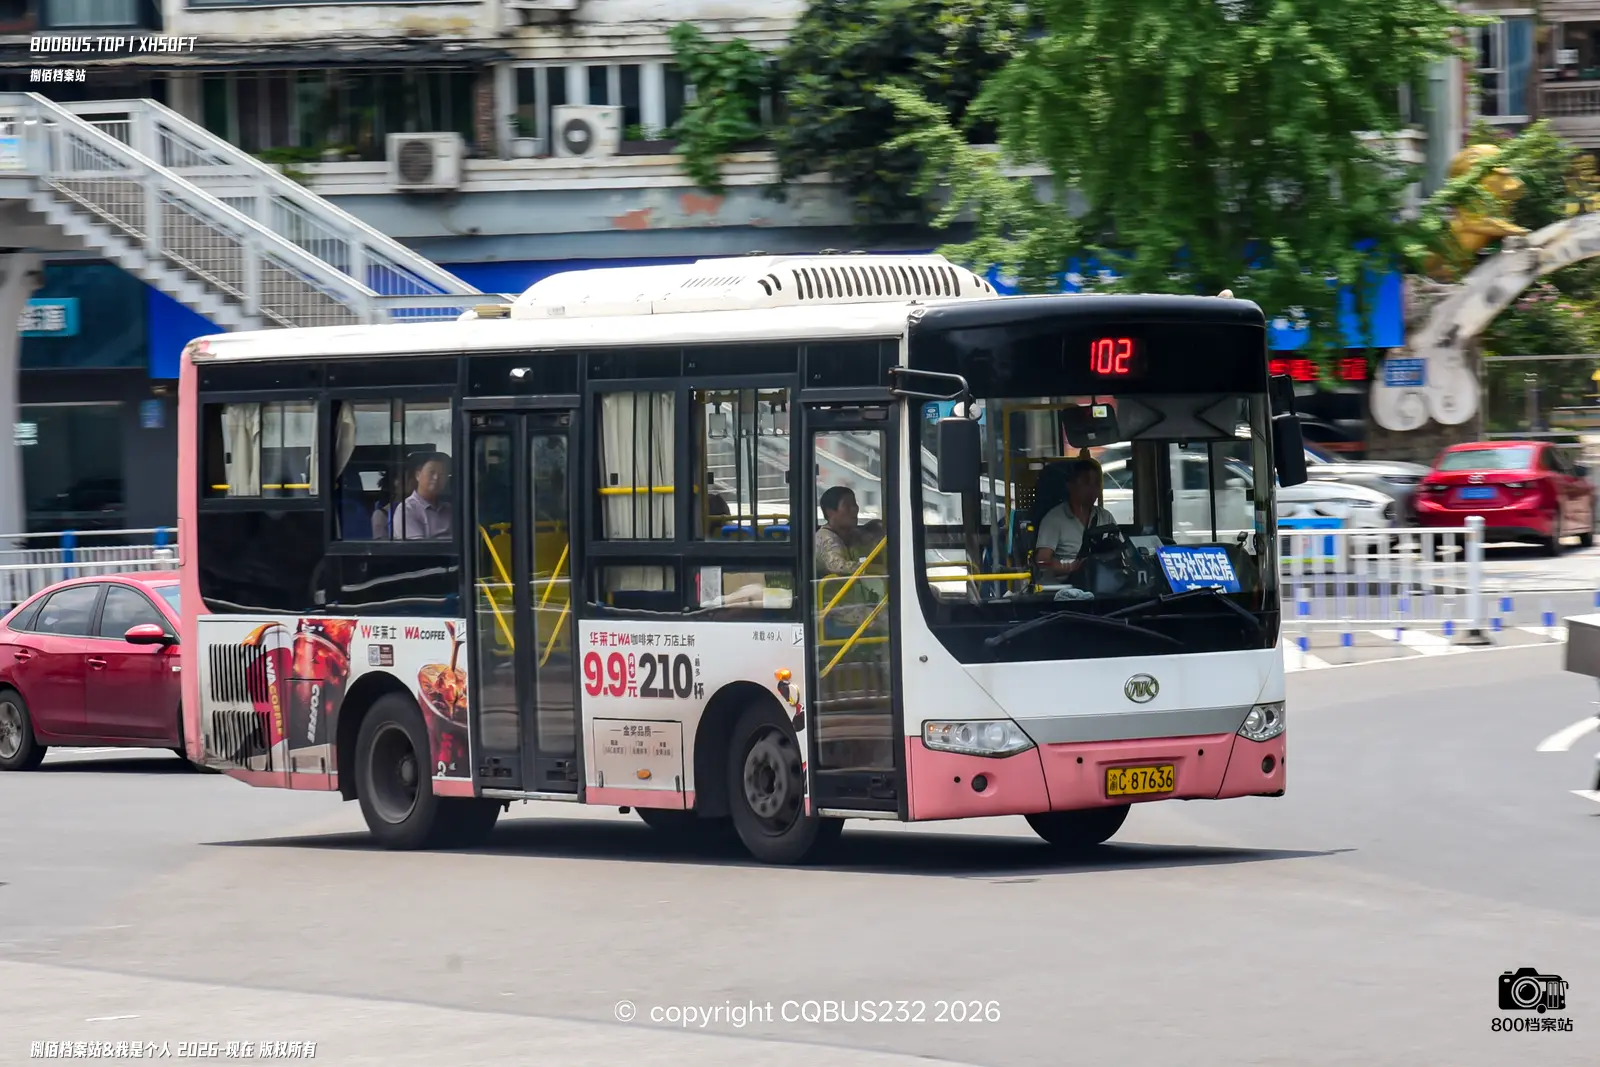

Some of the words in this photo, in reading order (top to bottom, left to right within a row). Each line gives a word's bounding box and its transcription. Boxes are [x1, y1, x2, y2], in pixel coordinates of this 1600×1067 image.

[1090, 338, 1132, 373] 102
[583, 651, 628, 698] 9.9
[627, 680, 638, 698] 元
[638, 652, 693, 699] 210
[693, 681, 705, 700] 杯
[306, 683, 321, 744] COFFEE
